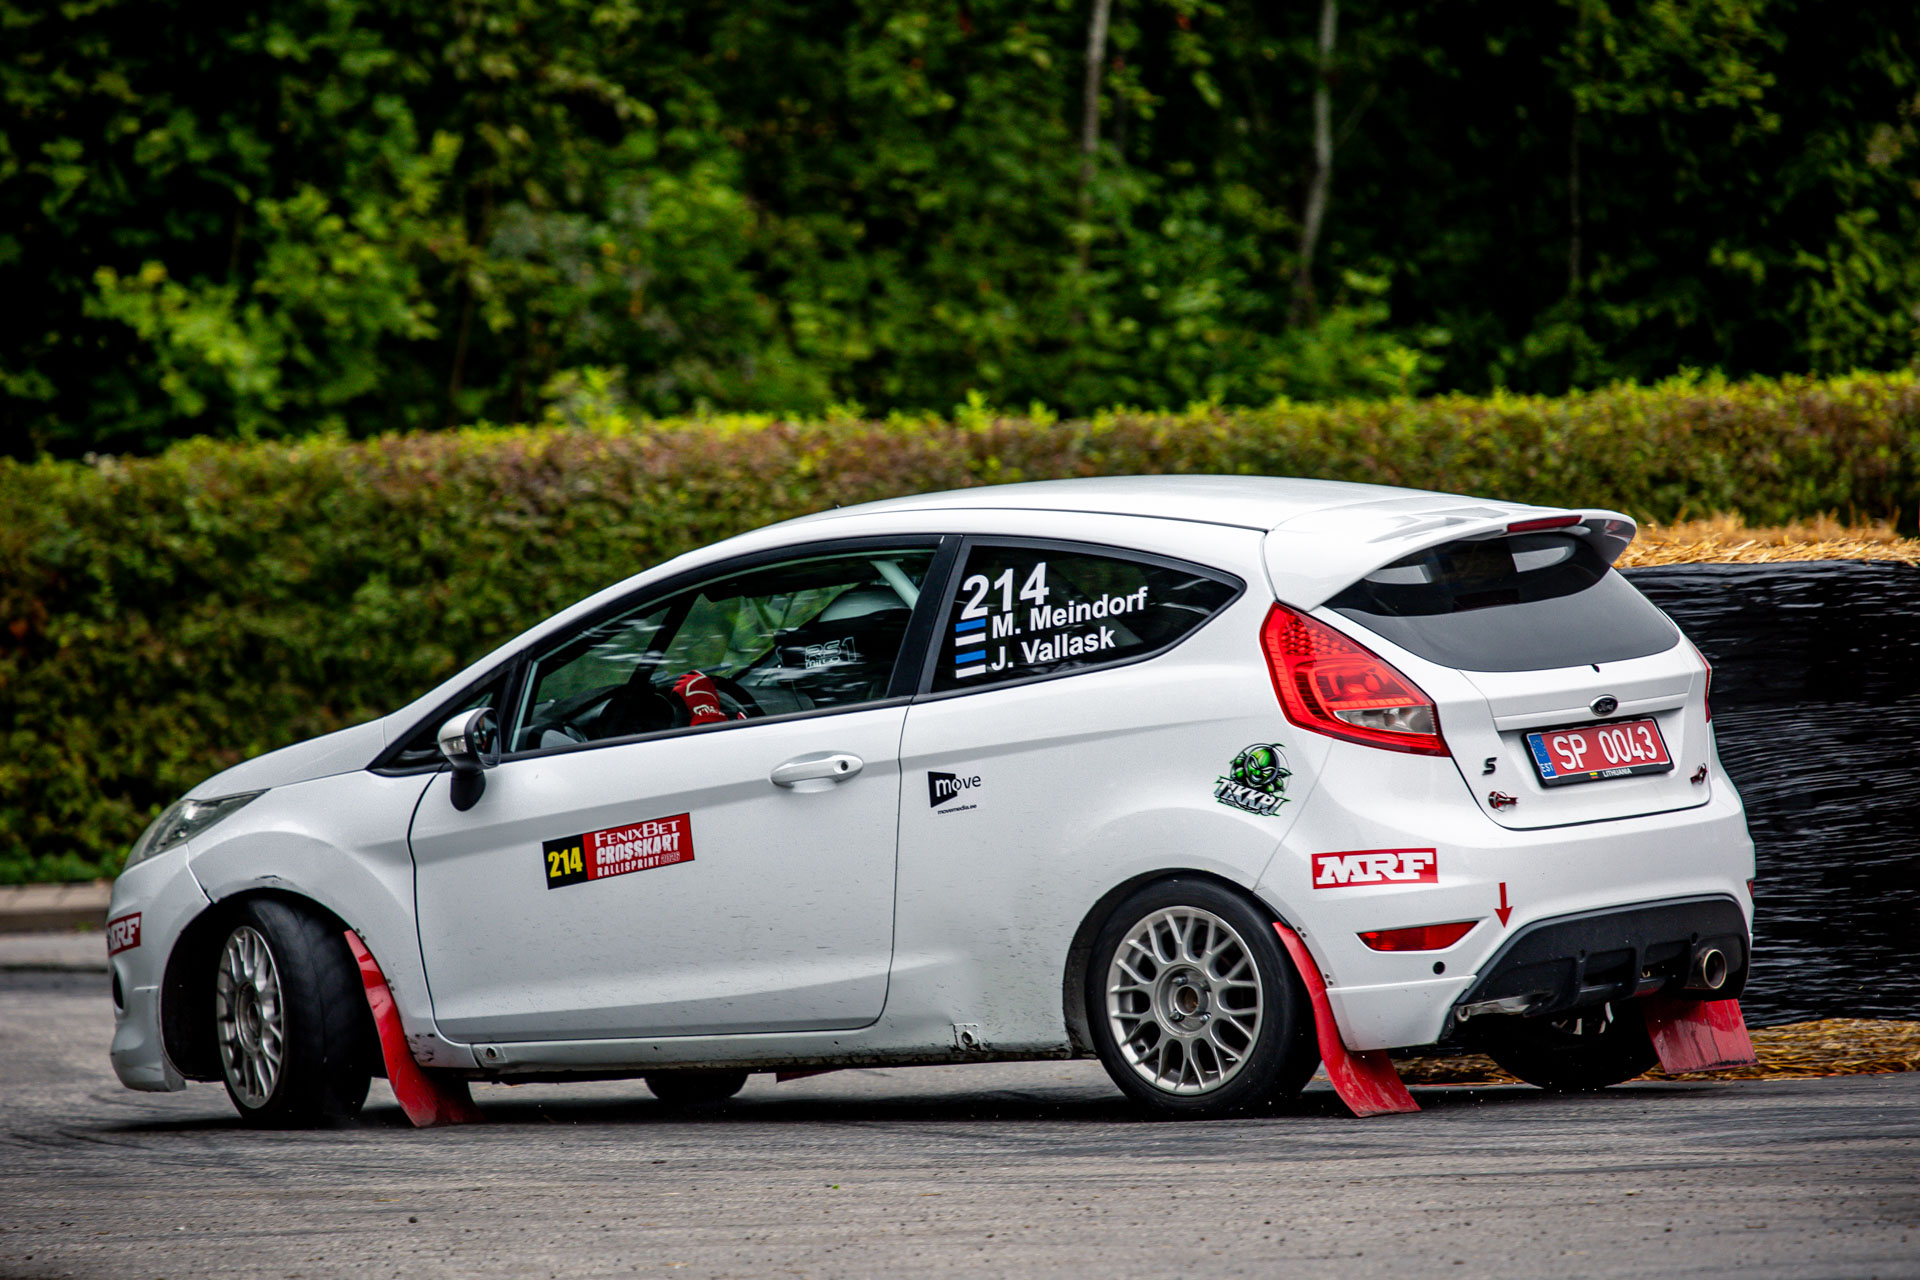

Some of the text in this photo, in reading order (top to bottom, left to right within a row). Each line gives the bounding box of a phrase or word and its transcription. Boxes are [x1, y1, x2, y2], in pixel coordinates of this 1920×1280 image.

[960, 562, 1050, 620] 214
[992, 586, 1148, 639] M. Meindorf
[991, 625, 1116, 671] J. Vallask
[1553, 725, 1658, 770] SP 0043
[1482, 757, 1498, 775] S
[1540, 762, 1554, 773] EST
[1602, 768, 1633, 778] LITHUANIA
[935, 775, 982, 797] move
[547, 847, 583, 879] 214
[596, 832, 680, 866] CROSSKART
[596, 855, 660, 878] RALLISPRINT
[1316, 852, 1434, 884] MRF
